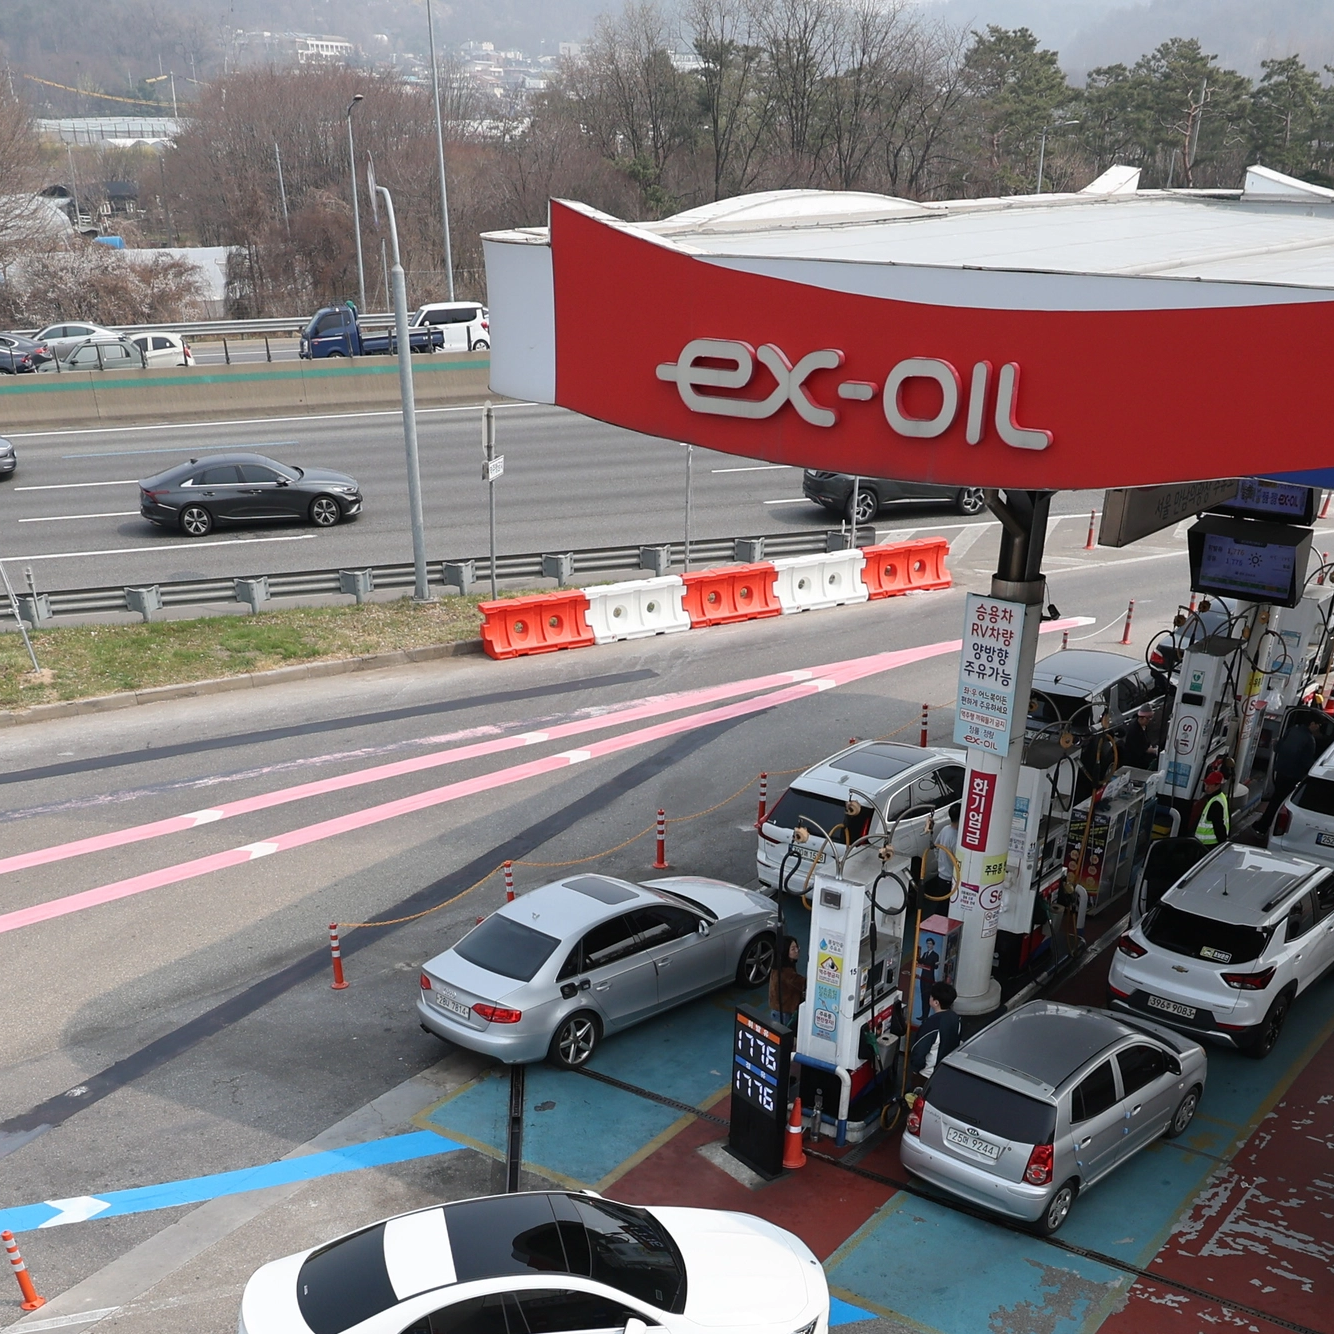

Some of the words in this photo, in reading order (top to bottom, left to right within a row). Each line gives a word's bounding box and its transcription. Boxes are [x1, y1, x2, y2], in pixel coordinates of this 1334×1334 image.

[655, 337, 1054, 451] ex-OIL
[975, 603, 1014, 624] 승용차
[971, 623, 1014, 647] RV차량
[972, 642, 1009, 666] 양방향
[963, 661, 1012, 687] 주유가능
[963, 734, 998, 751] ex-OIL
[966, 778, 989, 846] 화기엄금
[850, 968, 857, 976] 15
[1172, 1002, 1193, 1017] 9083
[738, 1029, 776, 1071] 1776
[736, 1070, 773, 1112] 1776
[972, 1139, 994, 1155] 9244
